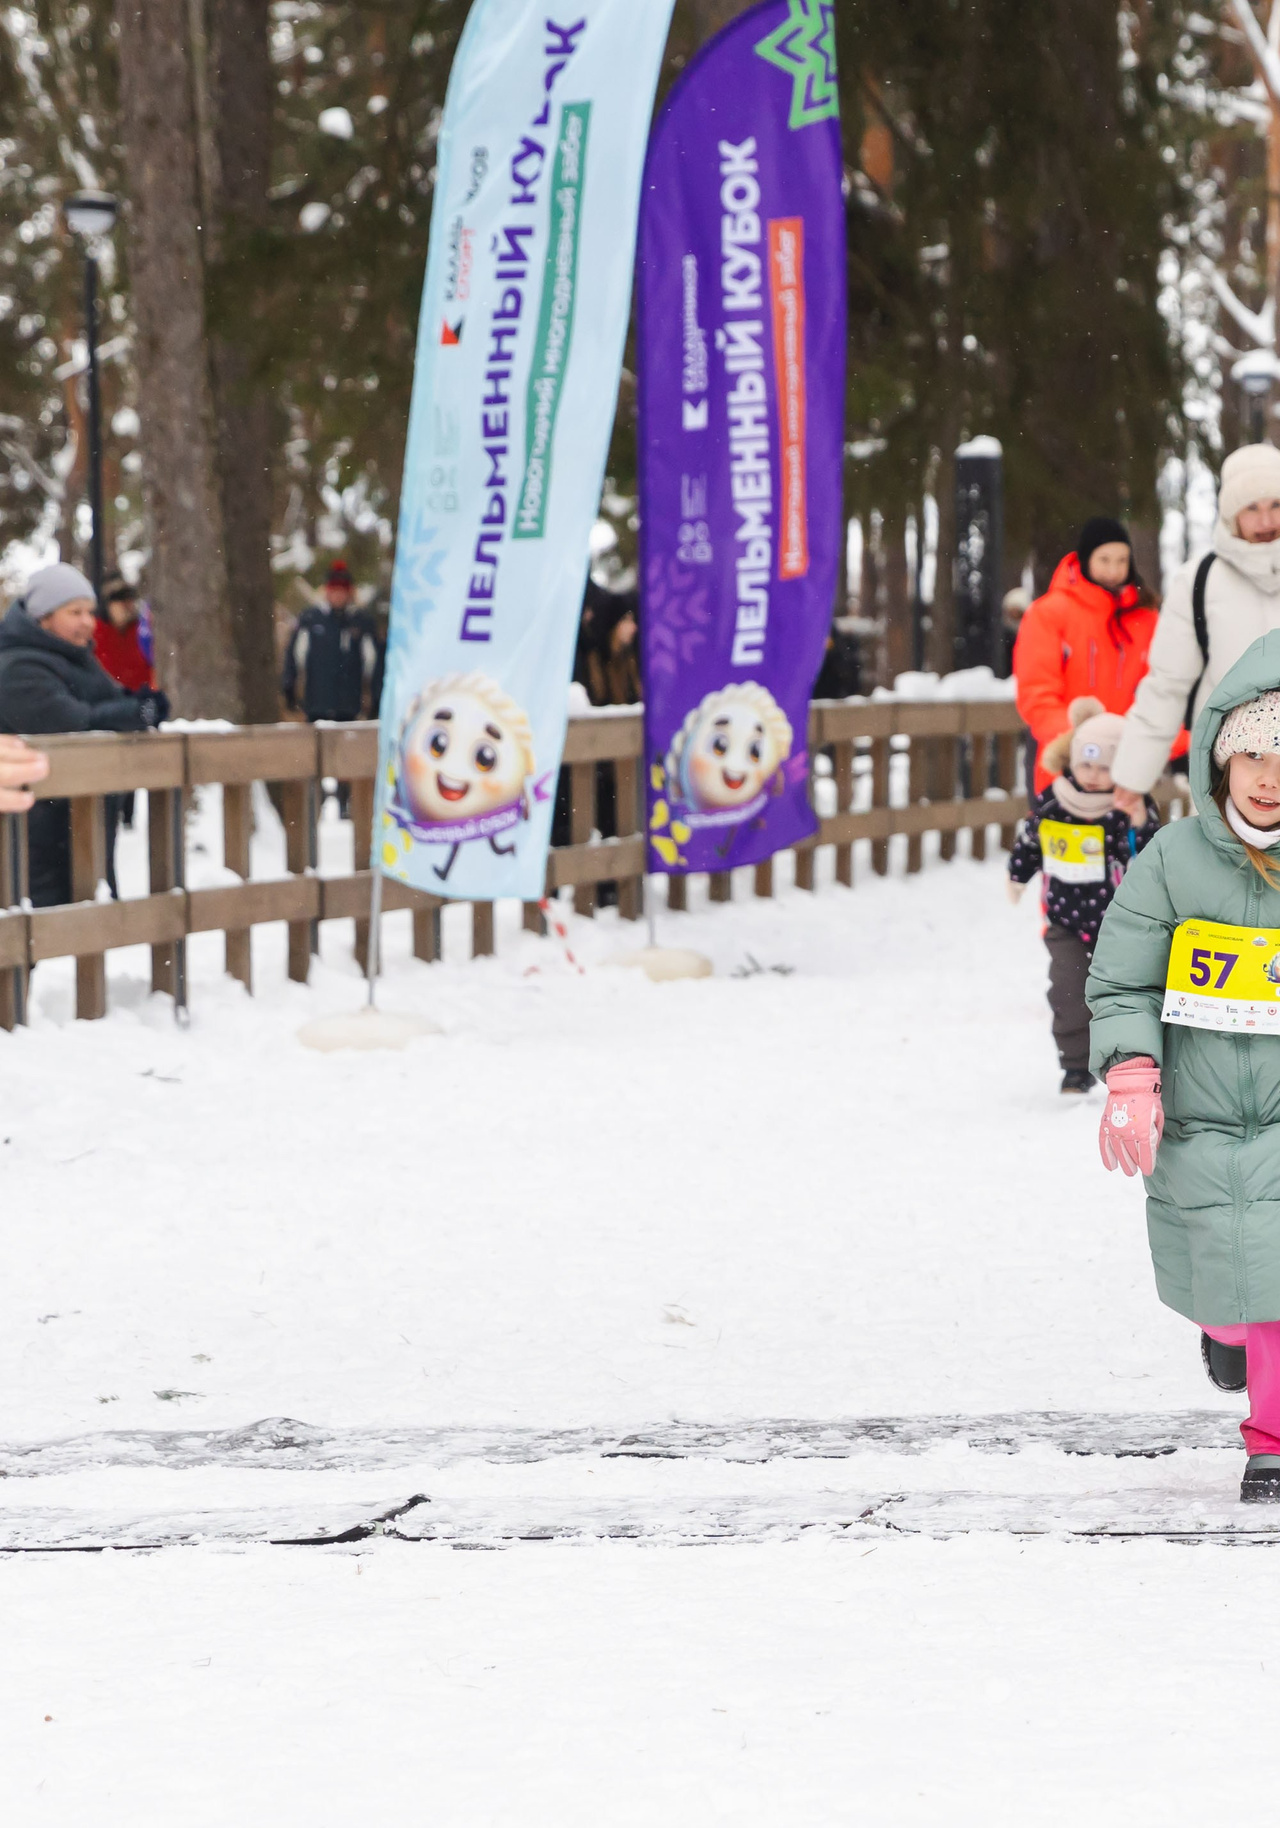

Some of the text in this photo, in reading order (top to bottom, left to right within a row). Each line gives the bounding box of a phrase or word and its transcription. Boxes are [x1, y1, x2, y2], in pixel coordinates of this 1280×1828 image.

[559, 110, 584, 183] забег
[543, 187, 578, 373] многодневный
[458, 226, 534, 643] ПЕЛЬМЕННЫЙ
[714, 137, 772, 666] ПЕЛЬМЕННЫЙ КУБОК
[1048, 837, 1068, 857] 69
[1189, 948, 1239, 989] 57
